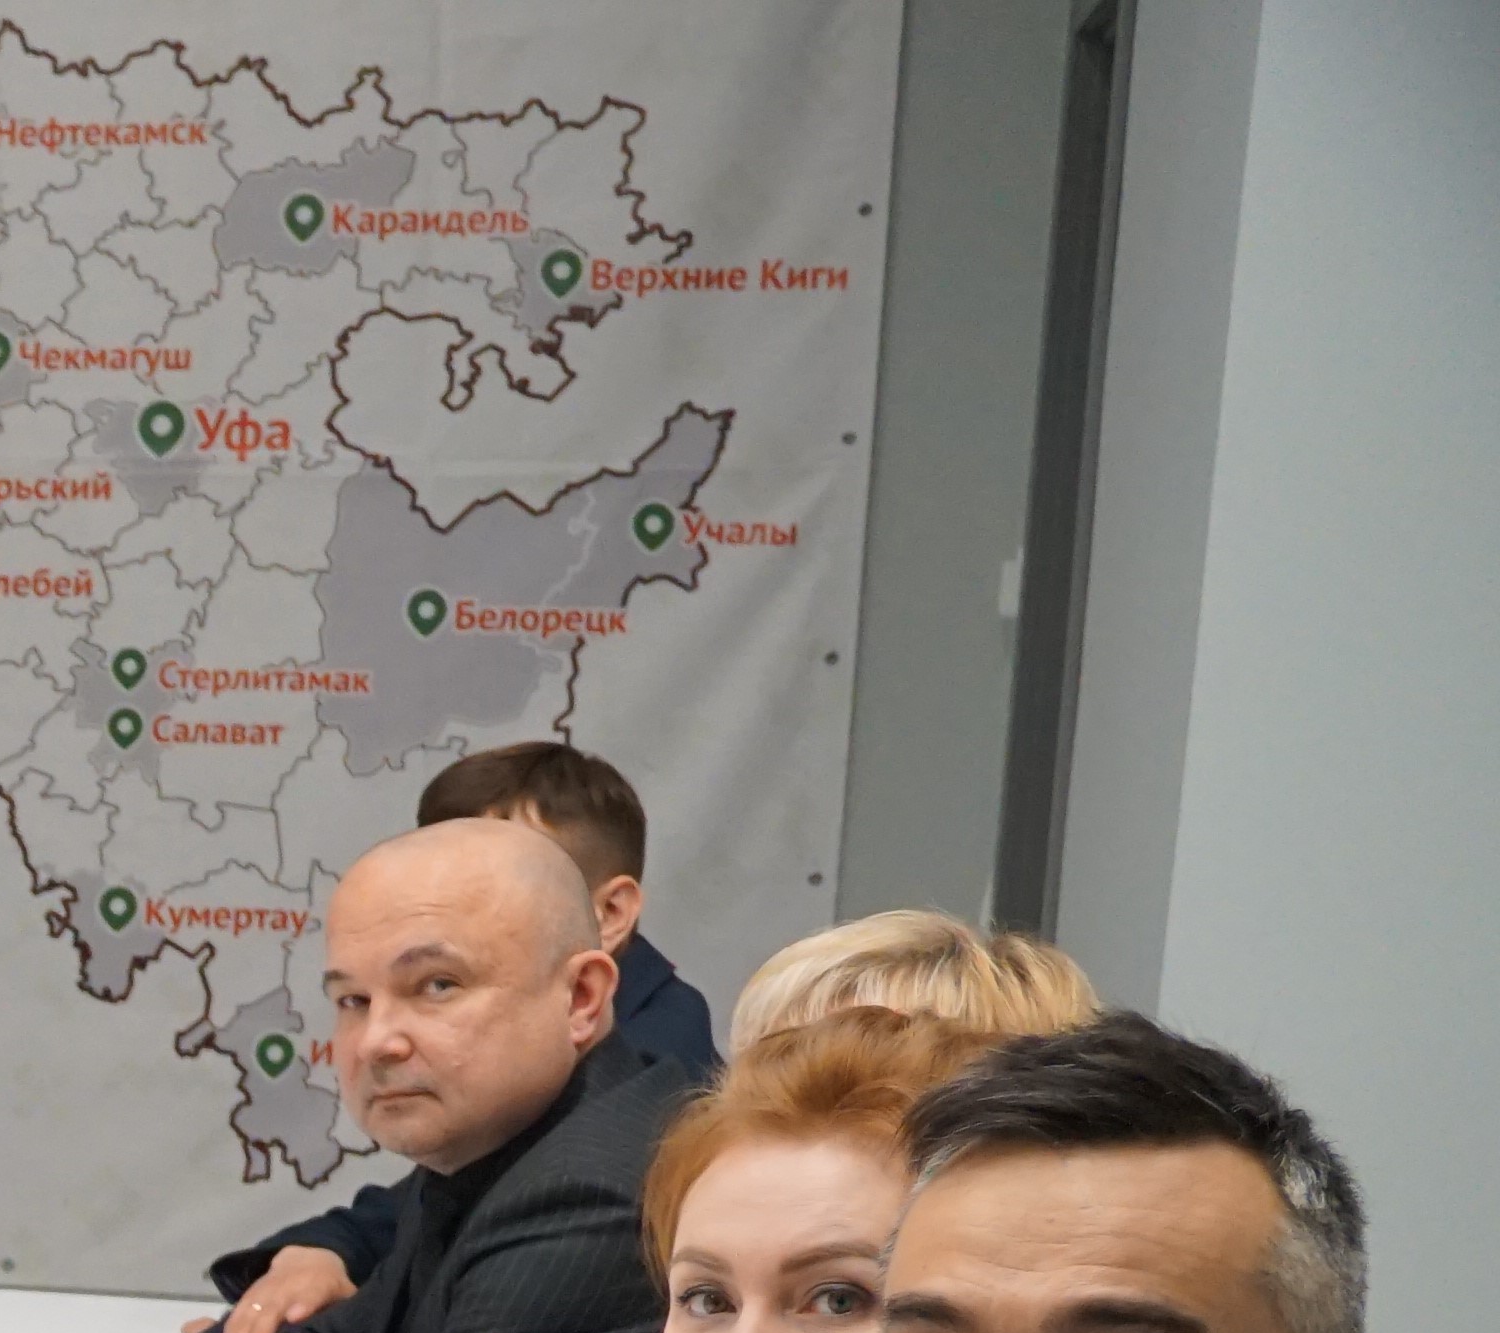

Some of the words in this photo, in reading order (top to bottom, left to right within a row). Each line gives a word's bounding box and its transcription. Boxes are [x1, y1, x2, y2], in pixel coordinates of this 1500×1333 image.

[332, 205, 528, 238] Караидель
[591, 259, 747, 296] Верхние
[760, 261, 848, 290] Киги
[19, 343, 192, 377] Чекмагуш
[195, 408, 292, 462] Уфа
[684, 514, 797, 547] Учалы
[455, 601, 626, 638] Белорецк
[159, 661, 369, 695] Стерлитамак
[152, 715, 283, 744] Салават
[145, 900, 308, 936] Кумертау
